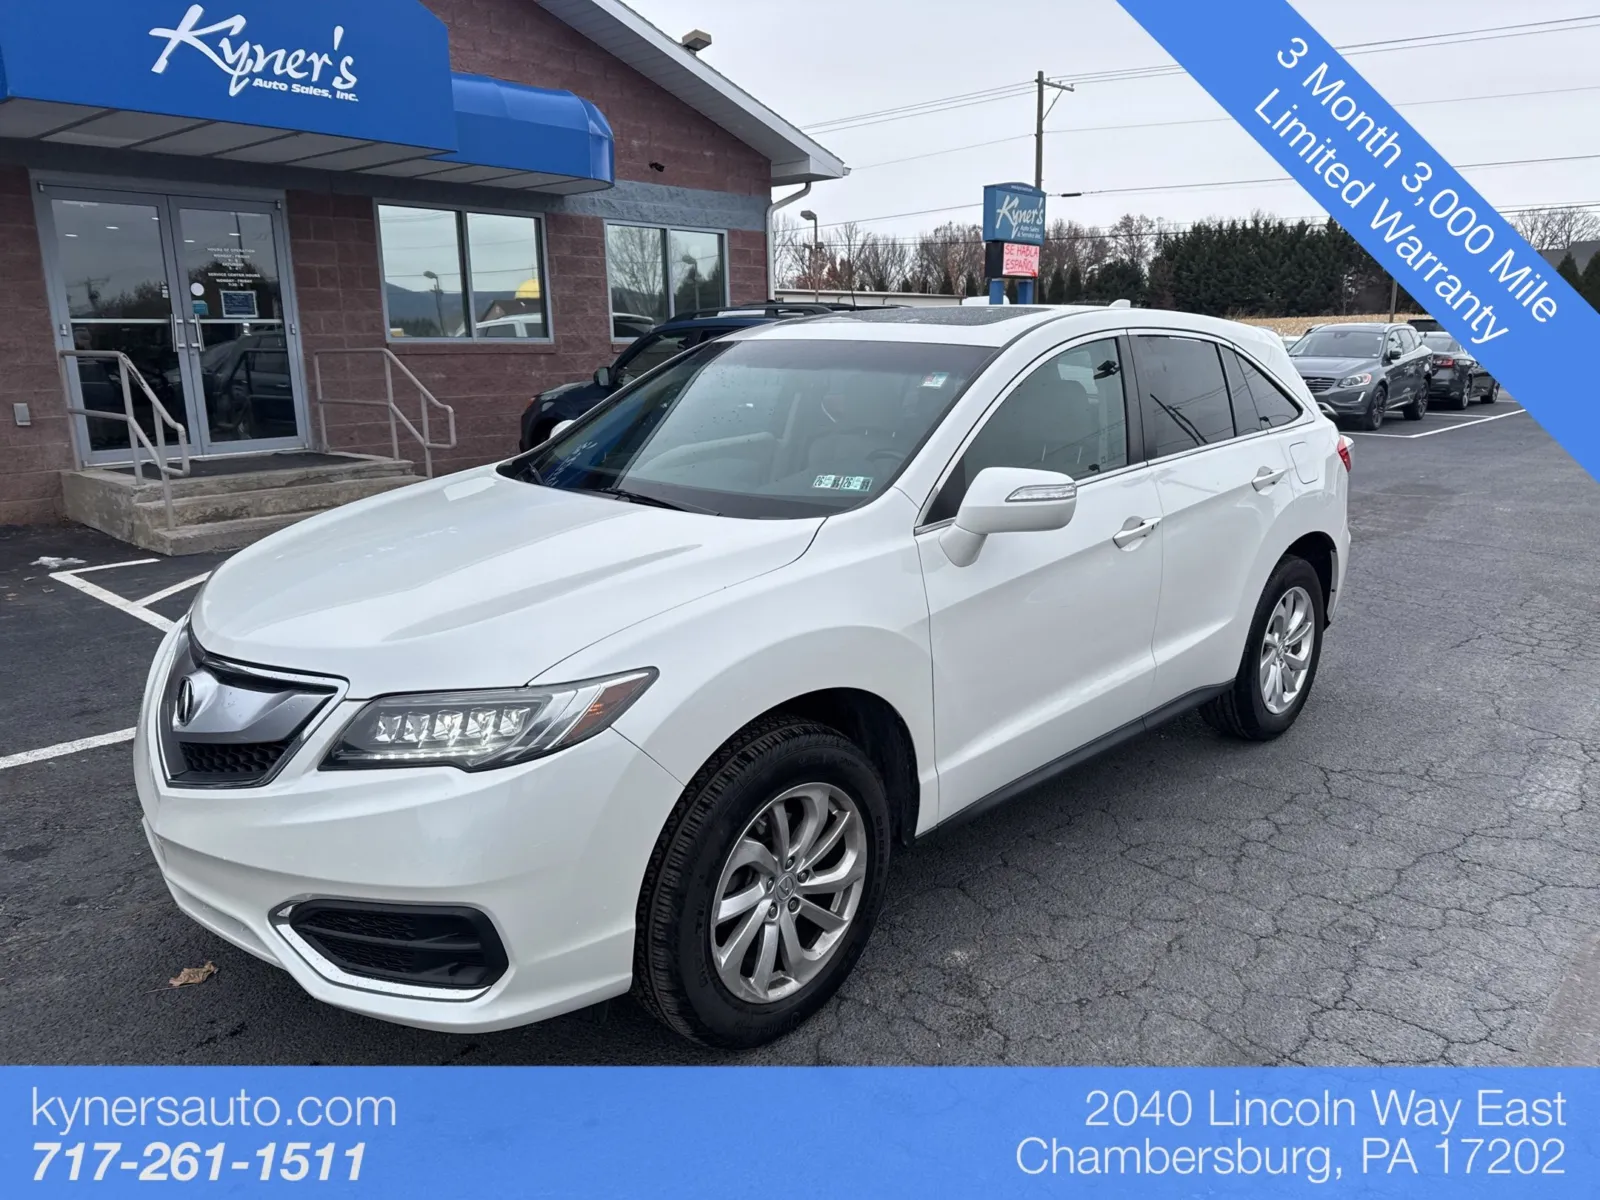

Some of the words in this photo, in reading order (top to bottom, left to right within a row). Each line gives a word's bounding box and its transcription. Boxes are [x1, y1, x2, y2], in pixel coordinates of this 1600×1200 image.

[149, 4, 358, 97] Kyner's
[252, 77, 288, 92] Auto
[291, 83, 332, 99] Sales,
[336, 90, 359, 102] Inc.
[996, 194, 1044, 239] Kyner's
[1005, 244, 1015, 255] SE
[1016, 245, 1038, 257] HABLA
